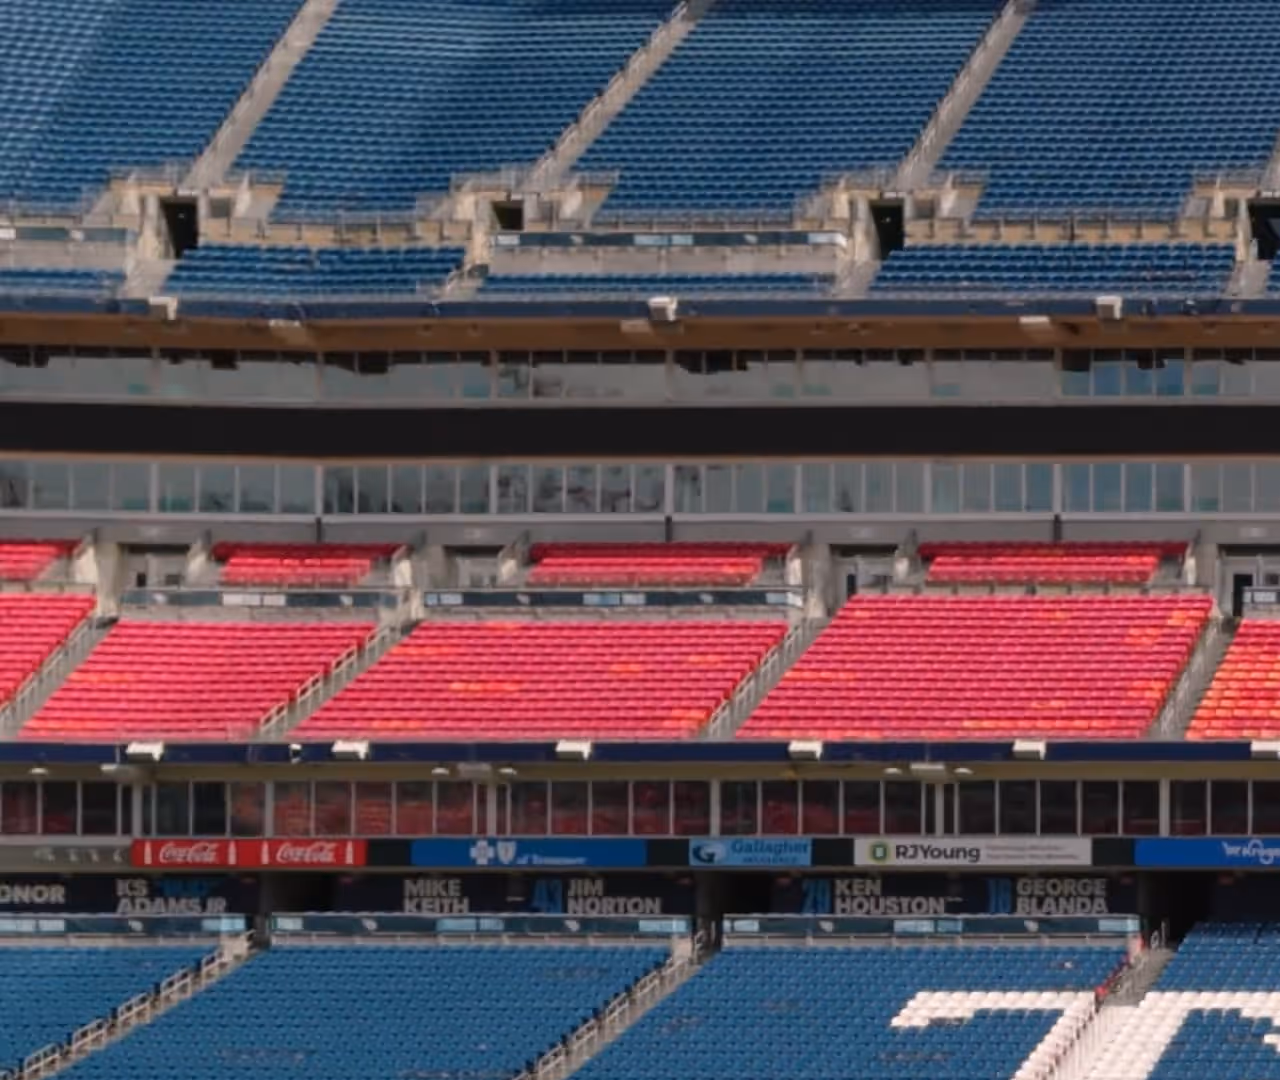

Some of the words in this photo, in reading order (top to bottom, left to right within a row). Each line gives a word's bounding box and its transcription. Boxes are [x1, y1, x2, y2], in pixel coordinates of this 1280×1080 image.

[403, 879, 462, 897] MIKE
[568, 879, 604, 897] JIM
[834, 879, 882, 896] KEN
[1016, 879, 1107, 896] GEORGE
[116, 897, 201, 914] ADAMS
[403, 897, 470, 915] KEITH
[568, 897, 662, 915] NORTON
[834, 897, 946, 915] HOUSTON
[1016, 897, 1109, 915] BLANDA
